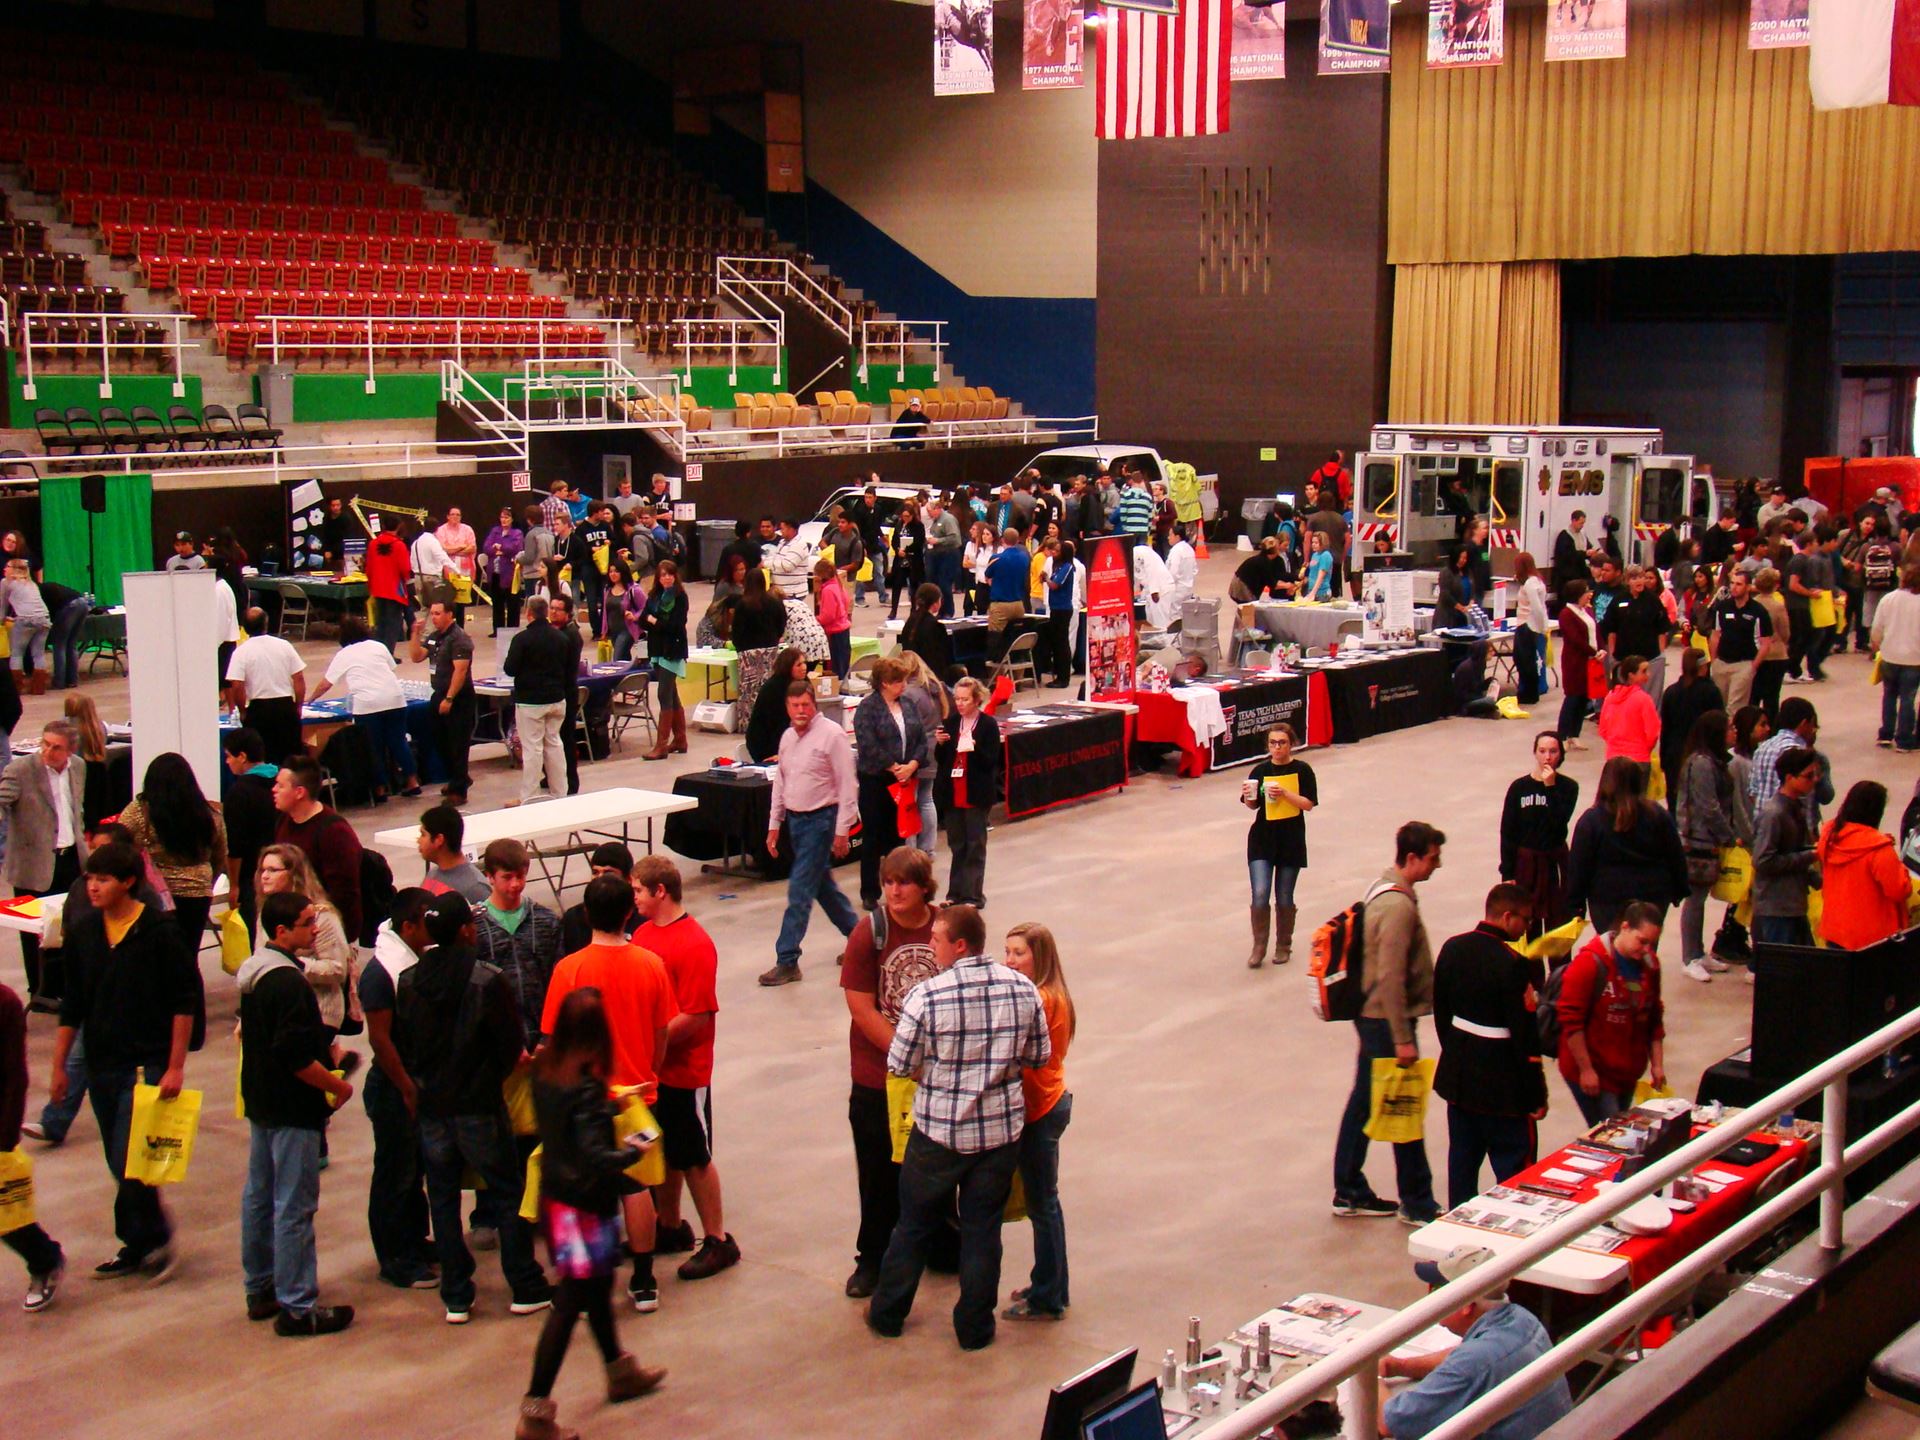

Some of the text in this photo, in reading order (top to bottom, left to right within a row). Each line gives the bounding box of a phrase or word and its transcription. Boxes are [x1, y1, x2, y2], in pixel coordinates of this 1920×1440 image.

[1750, 20, 1777, 31] 2000
[1573, 30, 1625, 42] NATIONAL
[1454, 40, 1492, 50] NATION
[1558, 44, 1614, 55] CHAMPION
[1240, 53, 1284, 63] NATIONAL
[1440, 52, 1491, 62] CHAMPION
[1024, 64, 1084, 74] 1977 NATIONAL
[1331, 59, 1381, 69] CHAMPION
[1032, 76, 1075, 85] CHAMPION
[687, 466, 702, 477] EXIT
[513, 474, 529, 487] EXIT
[1558, 470, 1605, 496] EMS
[586, 530, 607, 542] RICE
[1237, 699, 1302, 721] TEXAS TECH UNIVERSITY
[1013, 740, 1120, 779] TEXAS TECH UNIVERSITY
[1520, 794, 1534, 808] got
